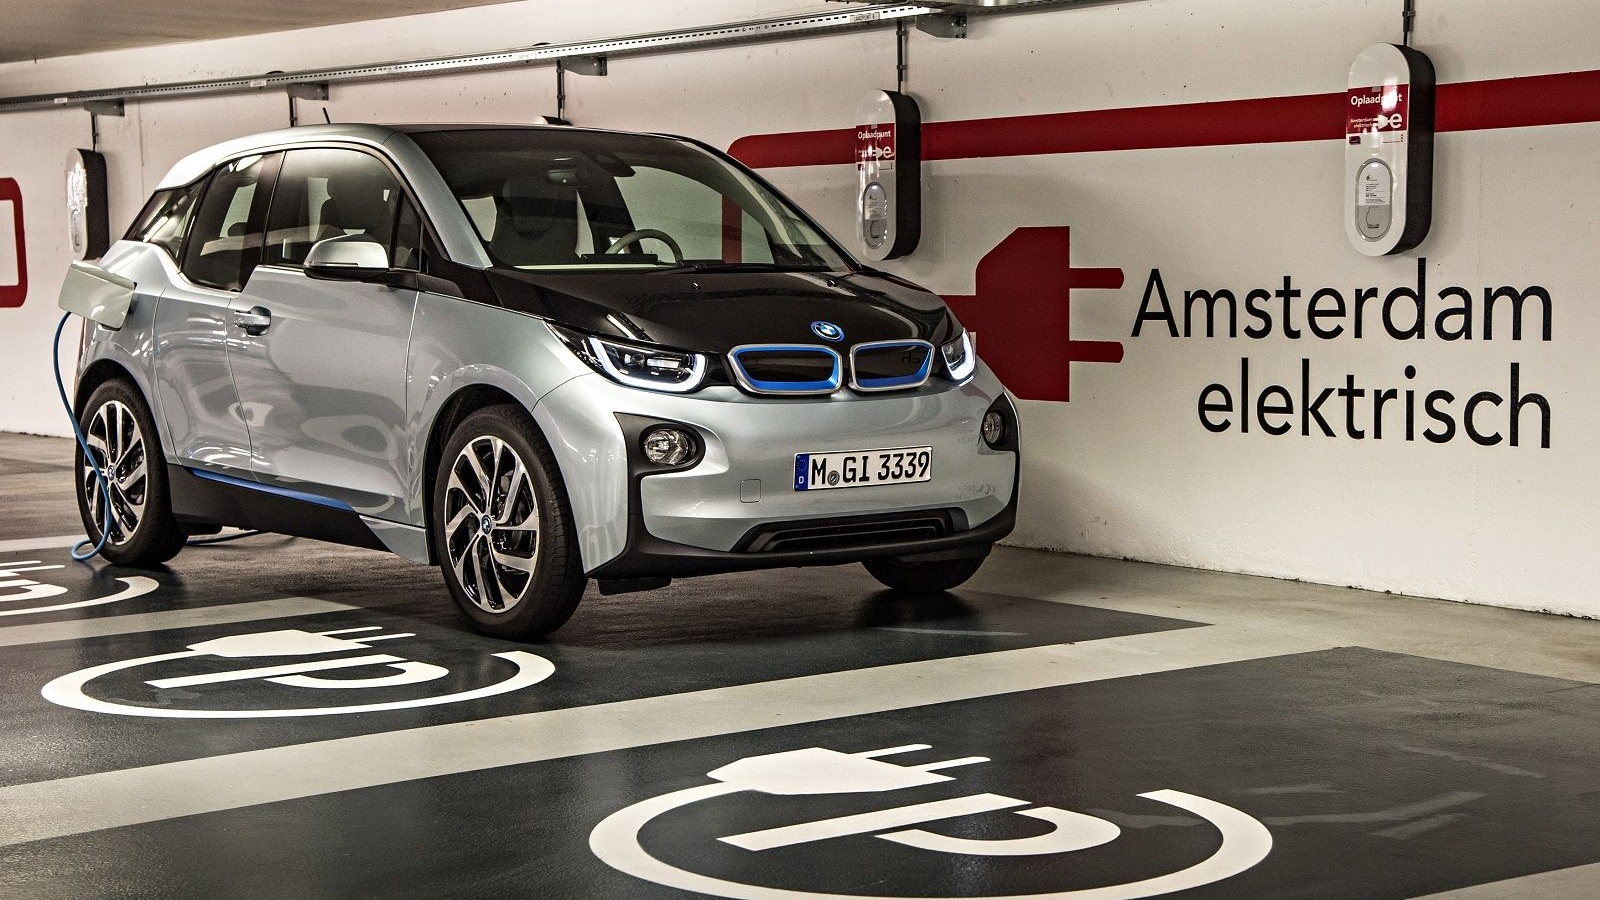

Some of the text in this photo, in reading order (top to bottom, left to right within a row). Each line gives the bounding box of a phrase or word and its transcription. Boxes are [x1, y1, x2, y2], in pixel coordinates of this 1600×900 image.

[1351, 94, 1402, 107] Oplaadt
[858, 130, 891, 140] Oplaadpunt
[1131, 257, 1552, 342] Amsterdam
[1197, 357, 1551, 449] elektrisch
[812, 452, 930, 485] M GI 3339
